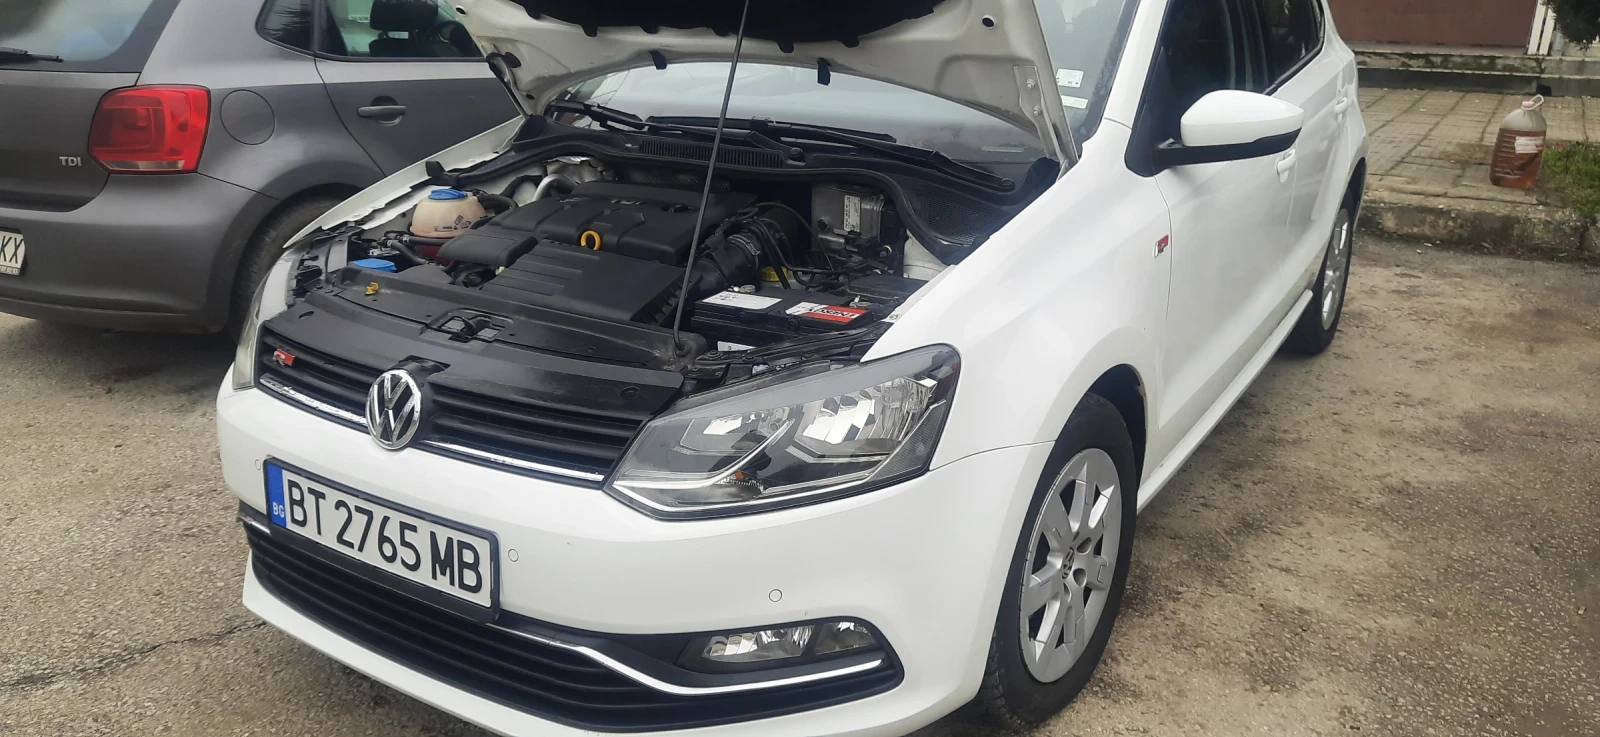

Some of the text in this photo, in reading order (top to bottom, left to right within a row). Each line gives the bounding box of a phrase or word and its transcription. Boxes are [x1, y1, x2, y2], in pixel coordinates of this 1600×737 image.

[59, 156, 82, 167] TDI
[272, 502, 285, 518] BG
[287, 479, 483, 594] BT 2765 MB
